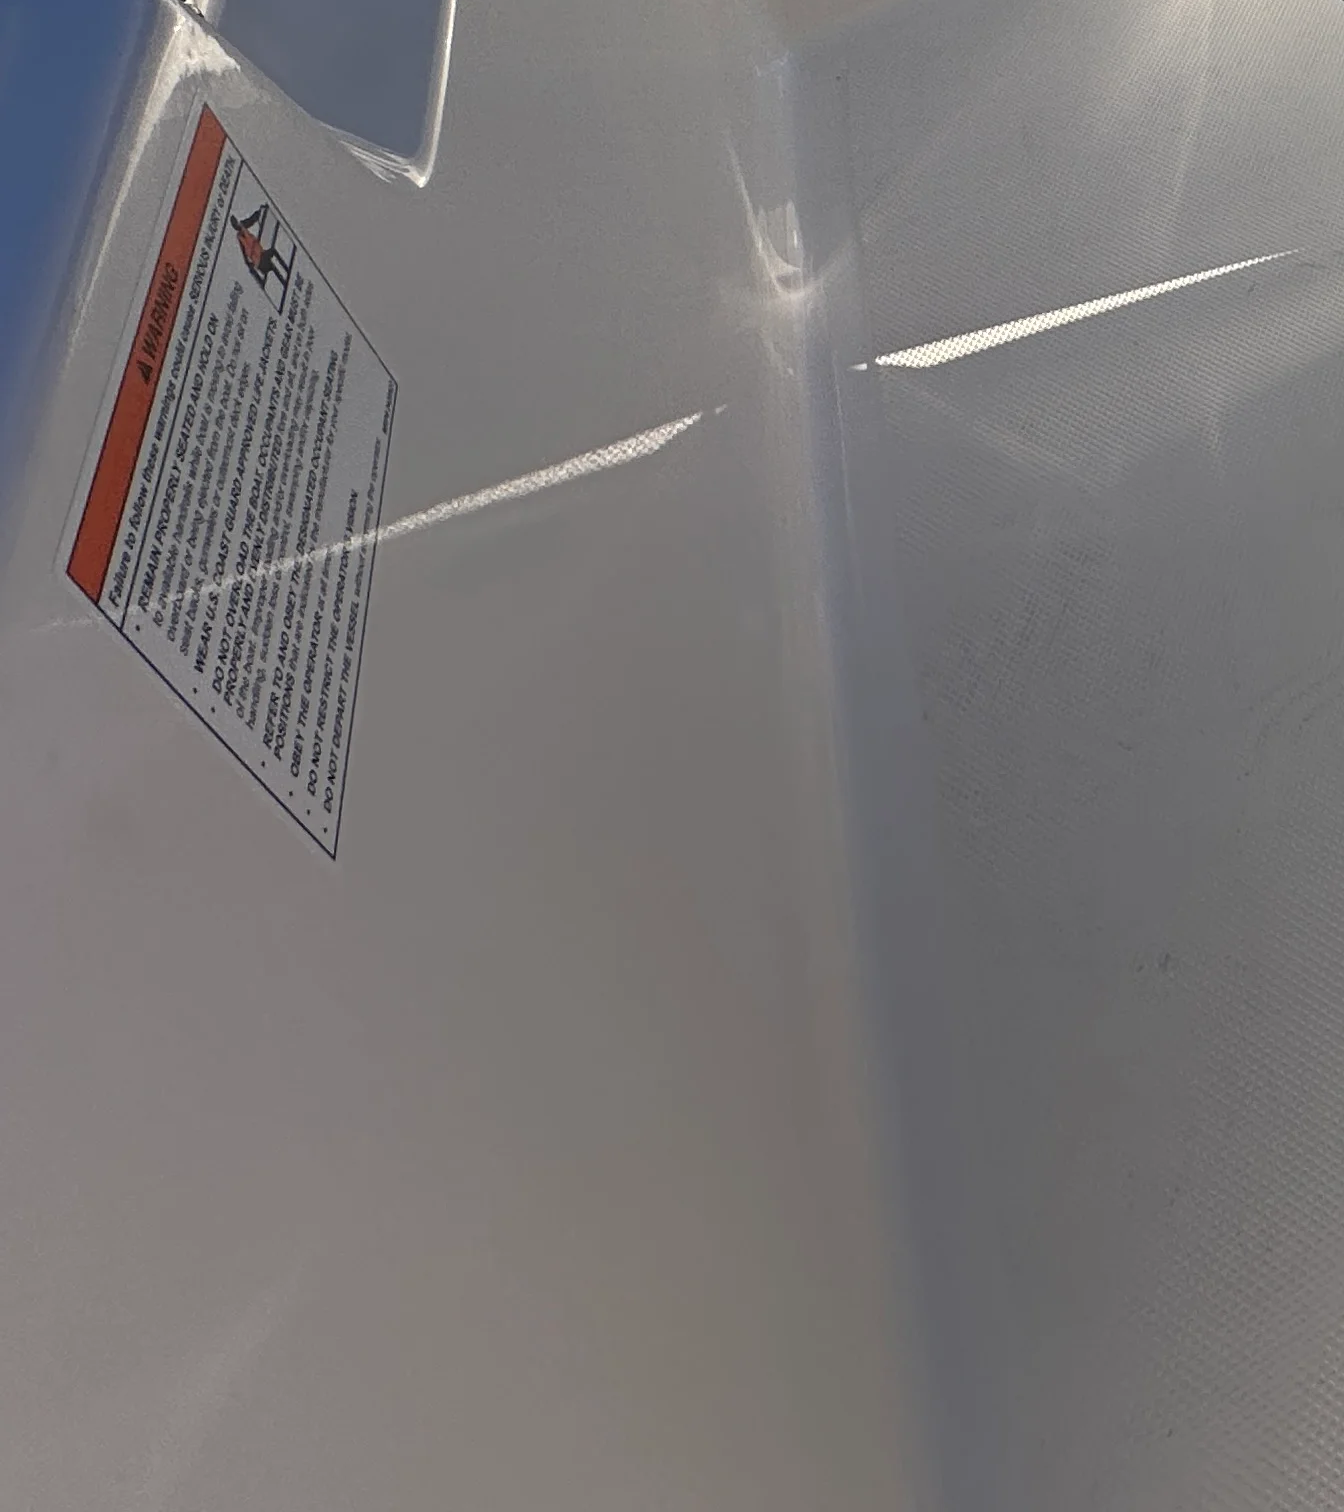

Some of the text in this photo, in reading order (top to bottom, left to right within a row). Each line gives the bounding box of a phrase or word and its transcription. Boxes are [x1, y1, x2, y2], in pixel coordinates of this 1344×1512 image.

[203, 205, 222, 252] INJURY
[189, 246, 212, 306] SERIOUS
[141, 260, 178, 362] WARNING
[168, 339, 187, 382] could
[279, 321, 293, 360] GEAR
[251, 371, 265, 404] LIFE
[273, 357, 285, 388] AND
[151, 377, 177, 444] warnings
[257, 384, 280, 468] OCCUPANTS
[137, 311, 219, 613] REMAIN PROPERLY SEATED AND HOLD ON
[140, 440, 161, 485] these
[207, 428, 222, 463] from
[235, 402, 258, 480] APPROVED
[127, 482, 150, 533] follow
[196, 463, 214, 511] ejected
[224, 477, 243, 533] GUARD
[186, 508, 204, 550] being
[242, 508, 256, 541] THE
[296, 467, 317, 556] DESIGNATED
[122, 527, 138, 552] to
[182, 547, 195, 569] or
[212, 532, 231, 588] COAST
[107, 548, 132, 608] Failure
[155, 542, 180, 611] available
[178, 620, 195, 657] seat
[212, 489, 223, 510] or
[223, 617, 247, 706] PROPERLY
[240, 580, 254, 618] AND
[258, 433, 282, 525] DISTRIBUTED
[224, 539, 249, 628] OVERLOAD
[151, 607, 164, 629] to
[205, 587, 220, 622] U.S.
[283, 587, 297, 631] OBEY
[345, 597, 359, 654] VESSEL
[193, 620, 213, 675] WEAR
[217, 626, 232, 665] NOT
[276, 630, 290, 667] AND
[303, 610, 322, 694] OPERATOR
[328, 622, 339, 654] THE
[211, 664, 225, 694] DO
[238, 674, 251, 702] the
[272, 665, 284, 690] TO
[341, 654, 351, 685] THE
[235, 699, 246, 720] of
[274, 672, 295, 761] POSITIONS
[288, 643, 300, 673] that
[297, 694, 310, 729] THE
[316, 655, 334, 731] RESTRICT
[262, 691, 279, 749] REFER
[332, 685, 347, 749] DEPART
[290, 731, 304, 778] OBEY
[311, 732, 323, 767] NOT
[327, 750, 339, 785] NOT
[307, 767, 318, 796] DO
[323, 785, 334, 814] DO
